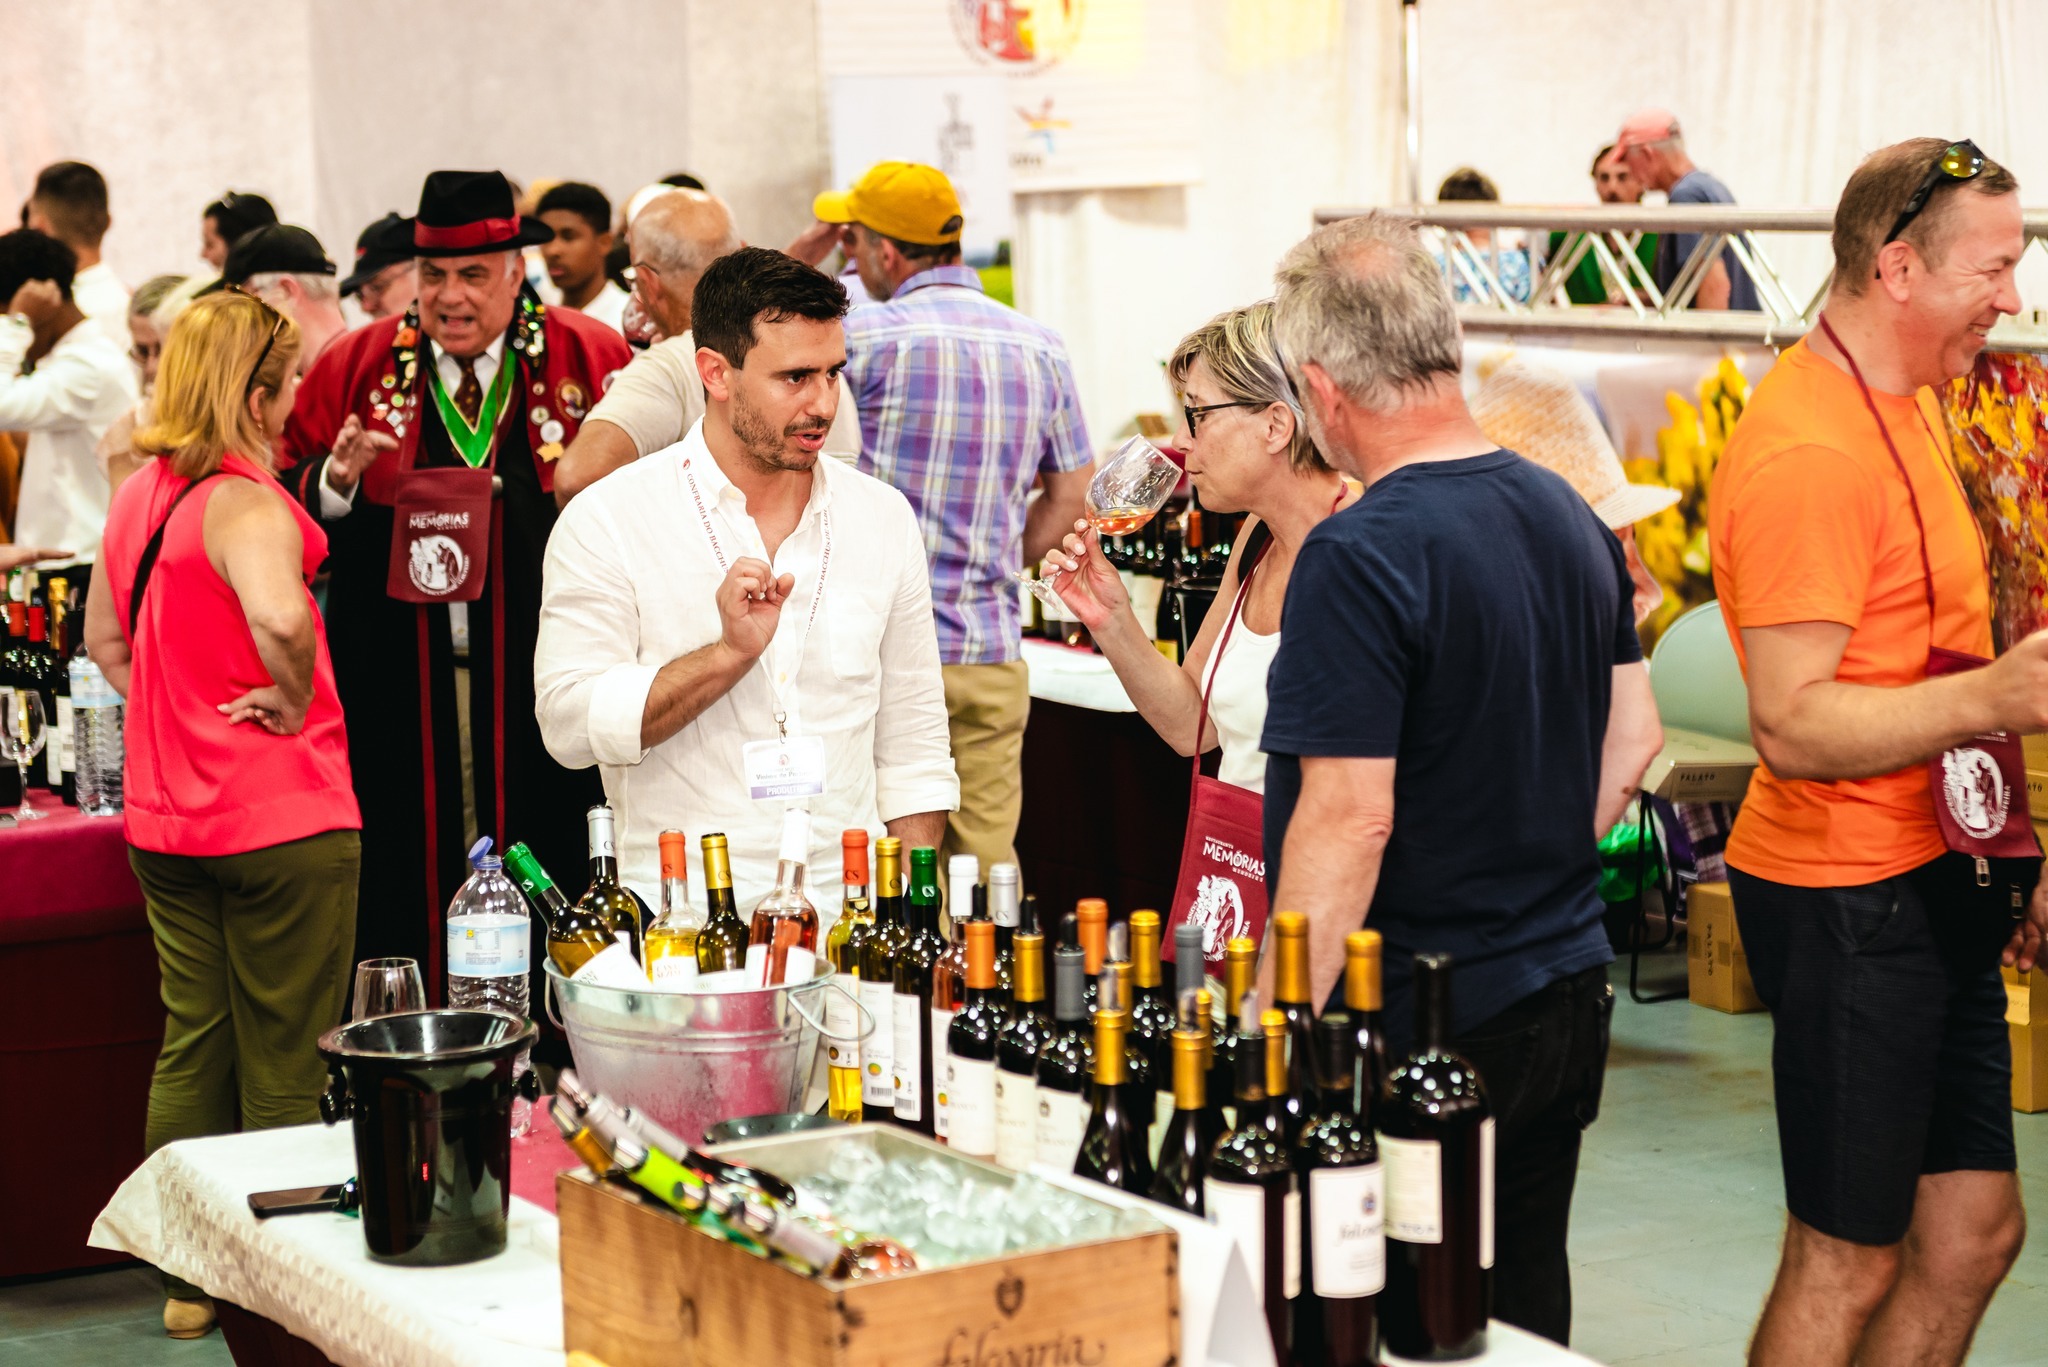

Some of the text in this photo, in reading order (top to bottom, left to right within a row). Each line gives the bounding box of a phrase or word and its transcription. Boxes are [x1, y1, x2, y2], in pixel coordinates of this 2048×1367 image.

[686, 473, 707, 520] CONFRARIA
[703, 520, 713, 534] DO
[820, 541, 831, 581] BACCHUS
[817, 582, 824, 596] DO
[1680, 773, 1716, 782] PALATO
[1203, 842, 1266, 876] MEMÓRIAS
[662, 864, 673, 874] CS
[844, 869, 859, 881] CS
[718, 870, 732, 882] CS
[522, 879, 534, 892] CS
[921, 885, 935, 897] CS
[995, 910, 1009, 921] CS
[1706, 923, 1714, 976] PALATO
